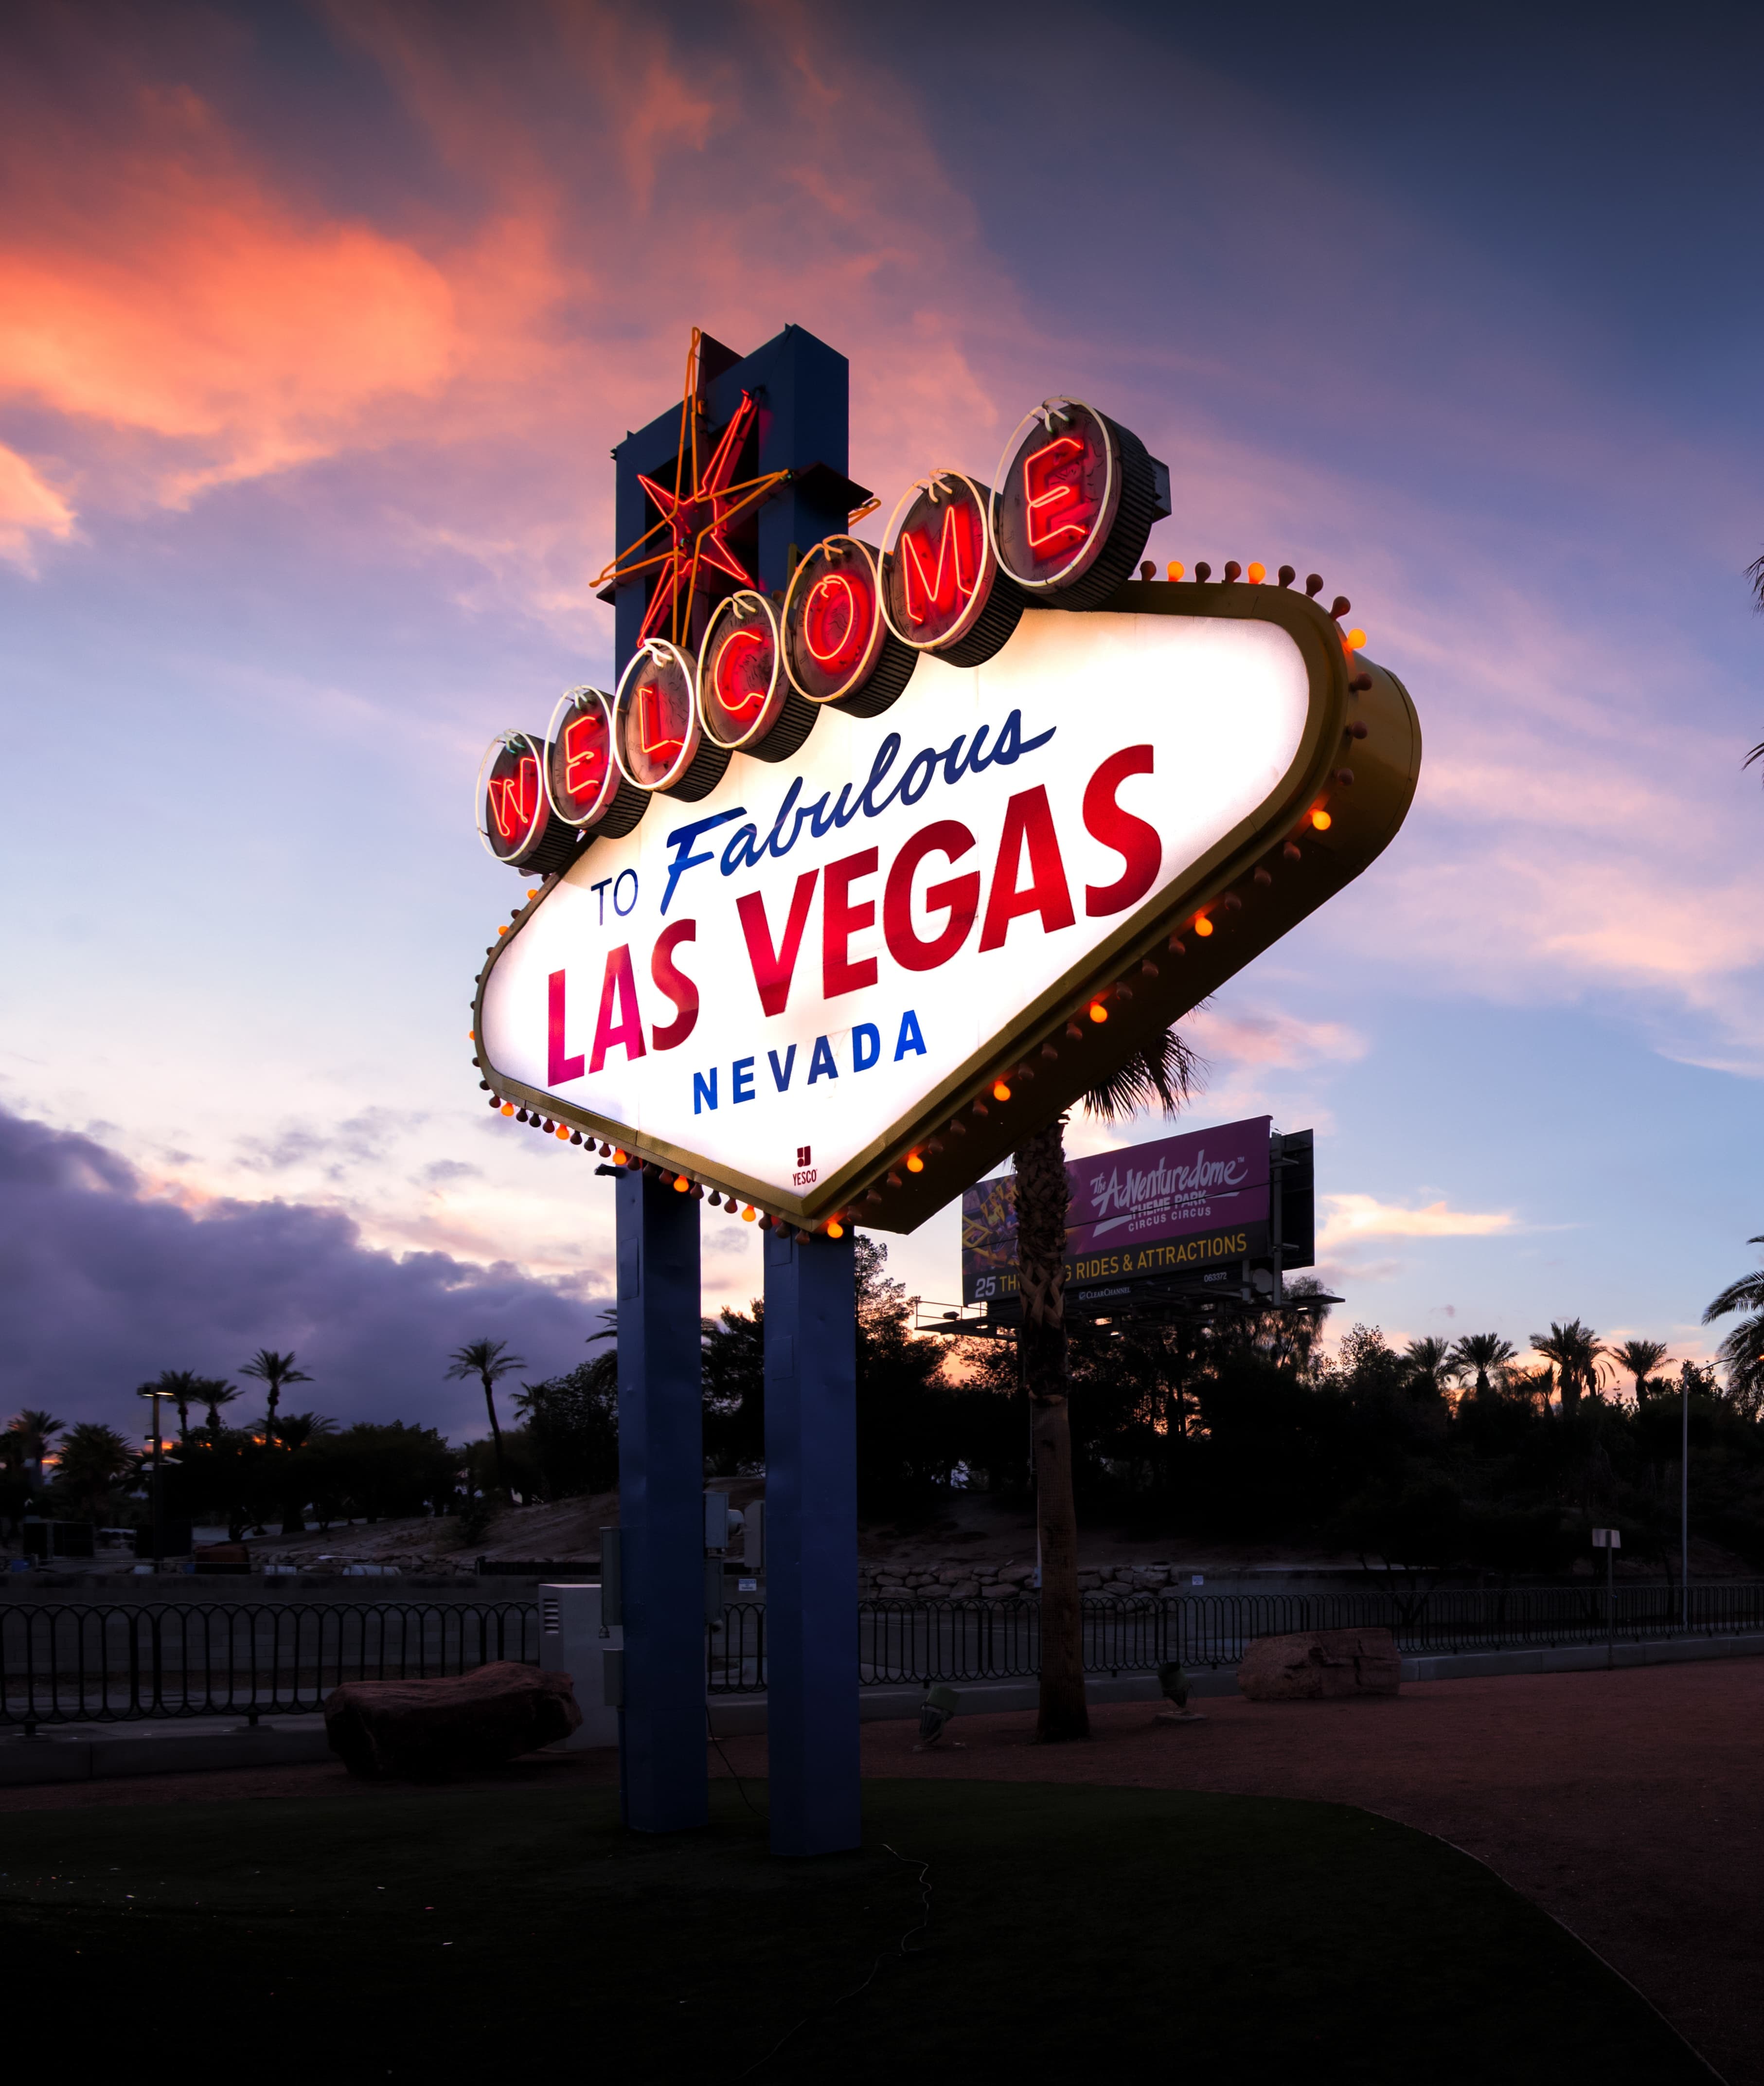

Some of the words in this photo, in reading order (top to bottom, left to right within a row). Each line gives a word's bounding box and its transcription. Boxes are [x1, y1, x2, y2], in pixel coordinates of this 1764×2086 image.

[488, 435, 1092, 841] WELCOME
[590, 868, 639, 926] TO
[659, 708, 1057, 916] Fabulous
[547, 918, 700, 1088] LAS
[735, 743, 1163, 1019] VEGAS
[693, 1009, 927, 1115] NEVADA
[1090, 1171, 1106, 1195] The
[1130, 1196, 1171, 1220] THEME
[1175, 1190, 1207, 1208] PARK
[1128, 1213, 1167, 1232] CIRCUS
[1171, 1206, 1212, 1221] CIRCUS
[975, 1275, 997, 1299] 25
[1076, 1255, 1119, 1280] RIDES
[1123, 1253, 1133, 1272] &
[1137, 1232, 1247, 1269] ATTRACTIONS
[1204, 1272, 1228, 1283] 063372
